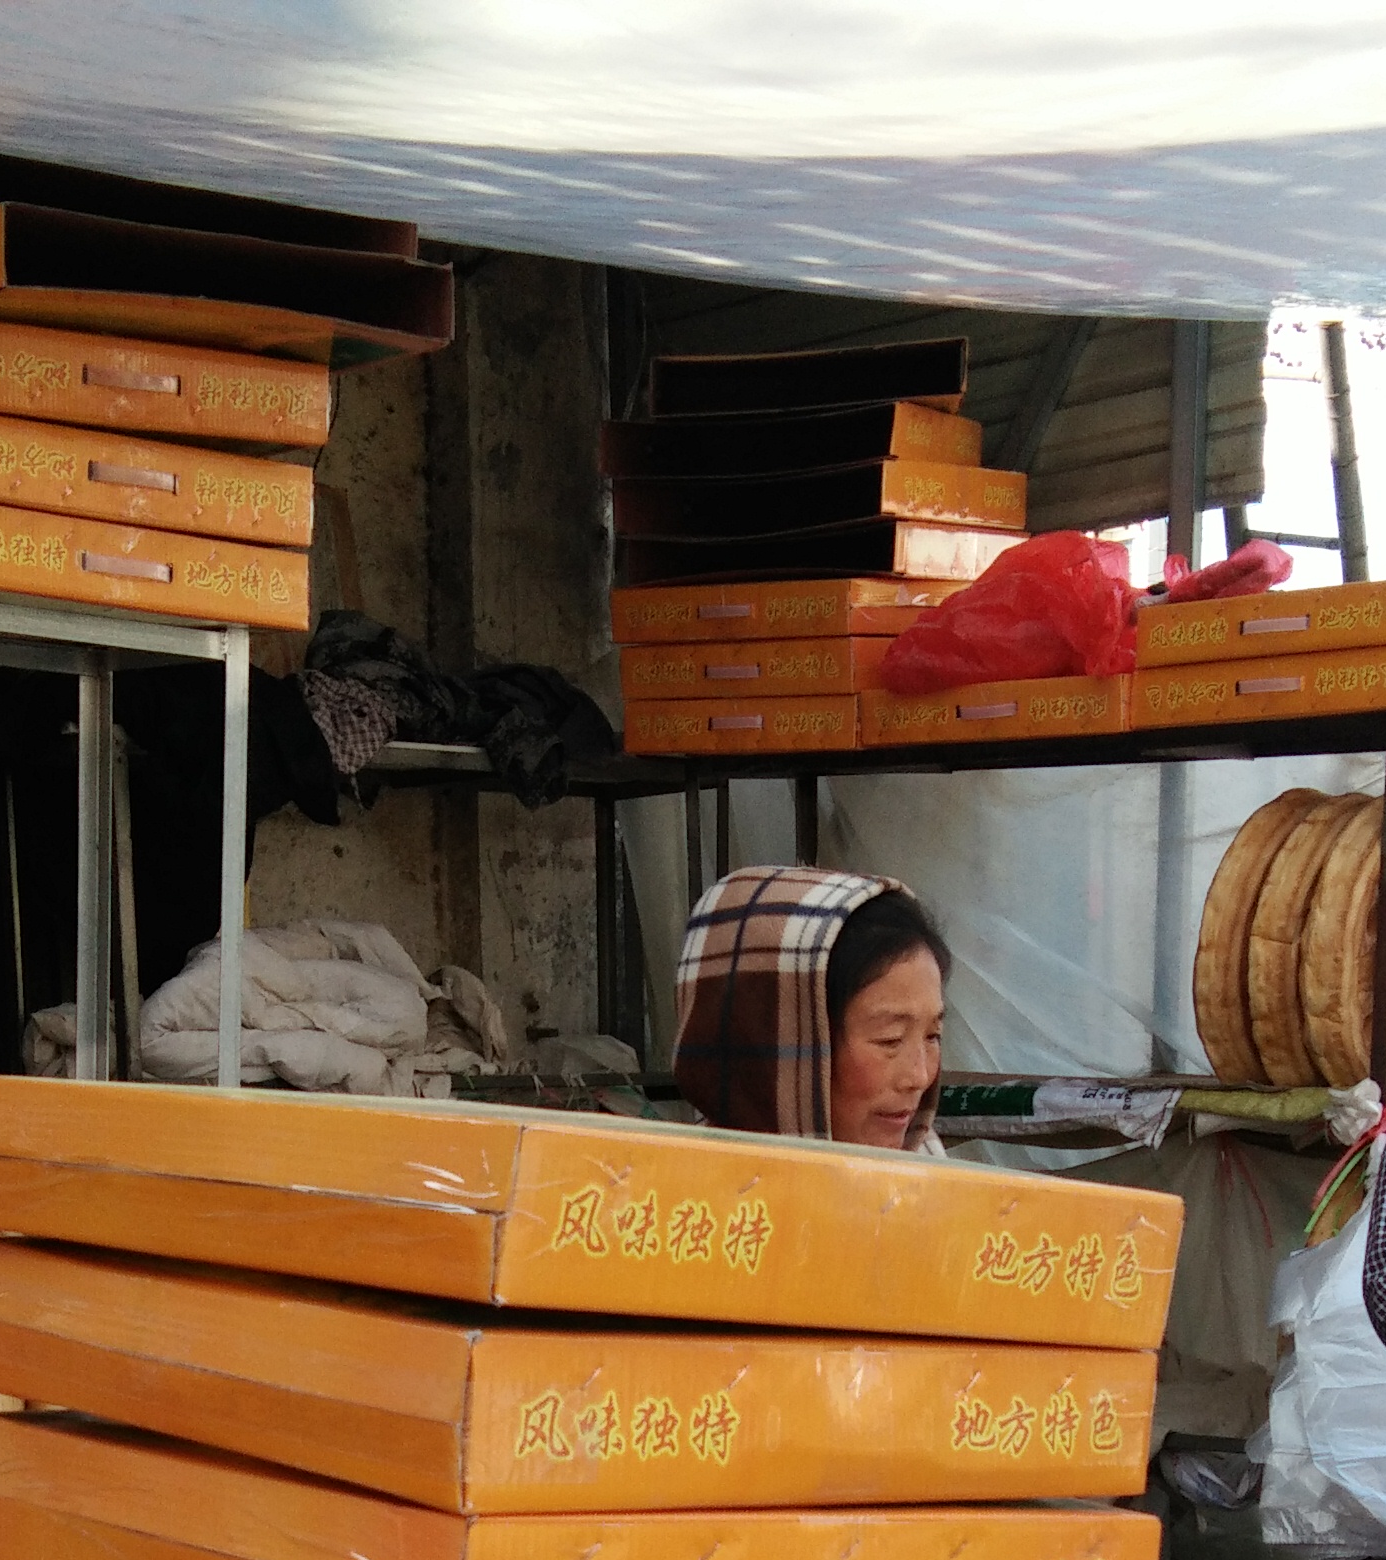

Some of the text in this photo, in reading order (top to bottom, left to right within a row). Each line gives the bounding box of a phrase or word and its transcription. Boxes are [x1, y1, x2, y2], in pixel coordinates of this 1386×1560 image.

[184, 562, 290, 602] 地方特色
[552, 1187, 774, 1273] 风味独特
[974, 1232, 1143, 1302] 地方特色
[516, 1386, 740, 1463] 风味独特
[950, 1391, 1122, 1459] 地方特色
